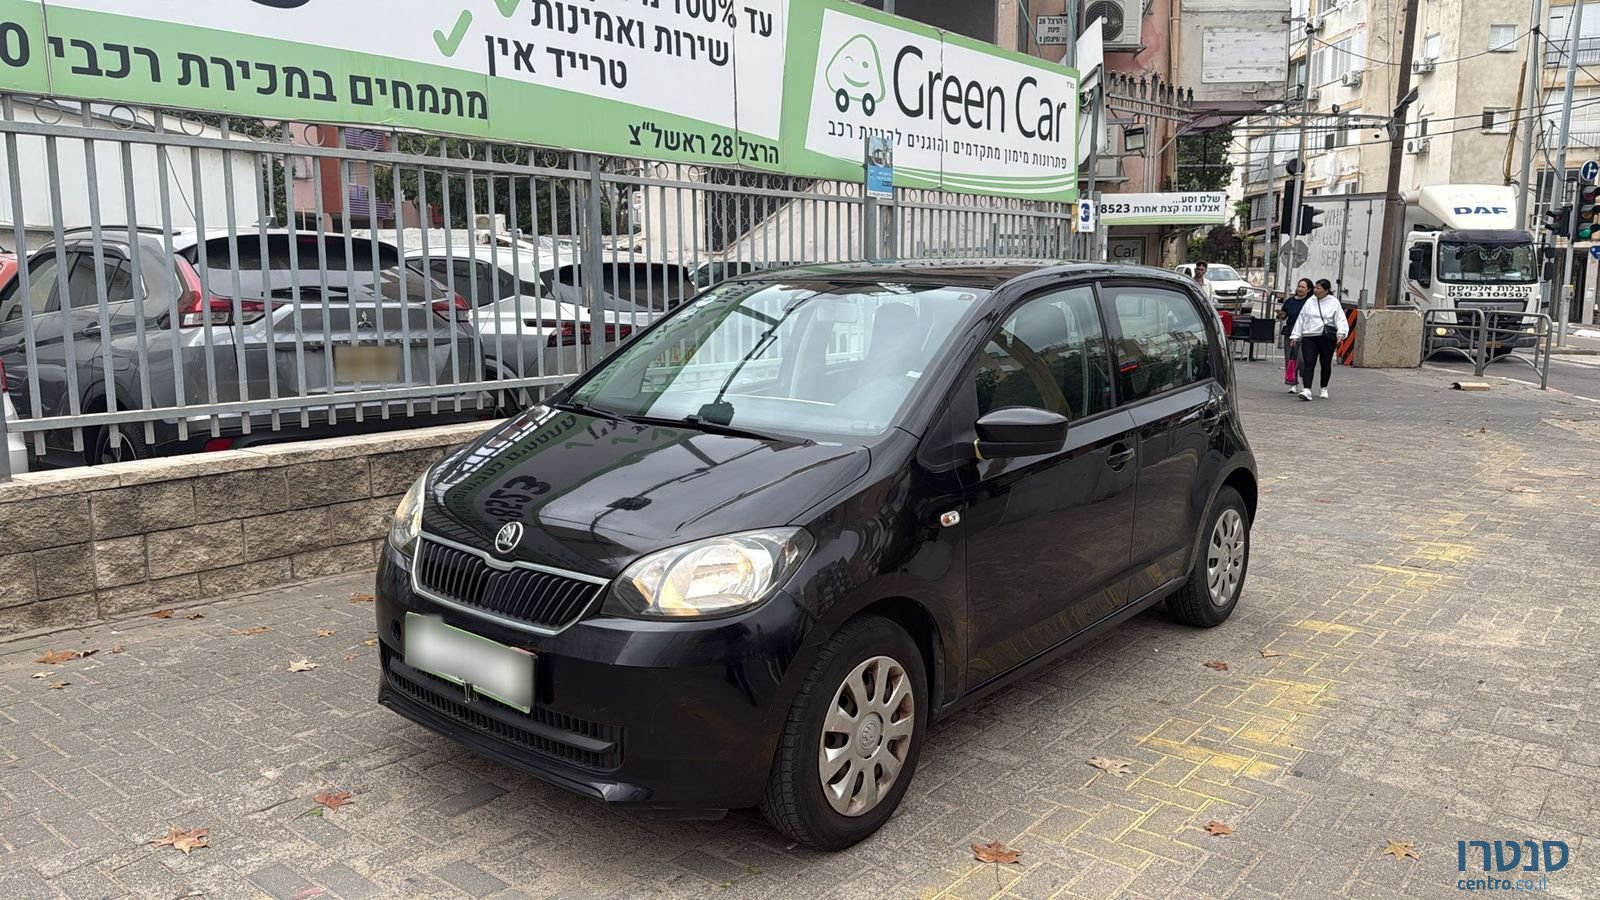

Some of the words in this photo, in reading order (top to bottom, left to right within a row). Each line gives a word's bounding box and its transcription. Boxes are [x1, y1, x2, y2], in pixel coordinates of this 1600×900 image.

[531, 0, 645, 49] ואמינות
[744, 7, 773, 37] עד
[654, 25, 729, 67] שירות
[48, 36, 161, 83] רכבי
[485, 35, 536, 77] אין
[546, 46, 627, 89] טרייד
[178, 53, 337, 102] במכירת
[350, 75, 488, 120] מתמחים
[894, 45, 1005, 133] Green
[1016, 76, 1067, 142] Car
[828, 120, 853, 139] רכב
[711, 133, 733, 158] 28
[740, 139, 778, 165] הרצל
[908, 134, 949, 153] והוגנים
[953, 141, 1001, 161] מתקדמים
[1004, 149, 1029, 164] מימון
[1032, 153, 1067, 169] פתרונות
[1195, 204, 1220, 212] אצלנו
[1200, 194, 1220, 203] שלם
[1100, 203, 1131, 214] 8523
[1133, 205, 1158, 213] אחרת
[1160, 205, 1180, 214] קצת
[1453, 206, 1508, 215] DAF
[1113, 244, 1138, 258] Car
[1497, 284, 1532, 292] הובלות
